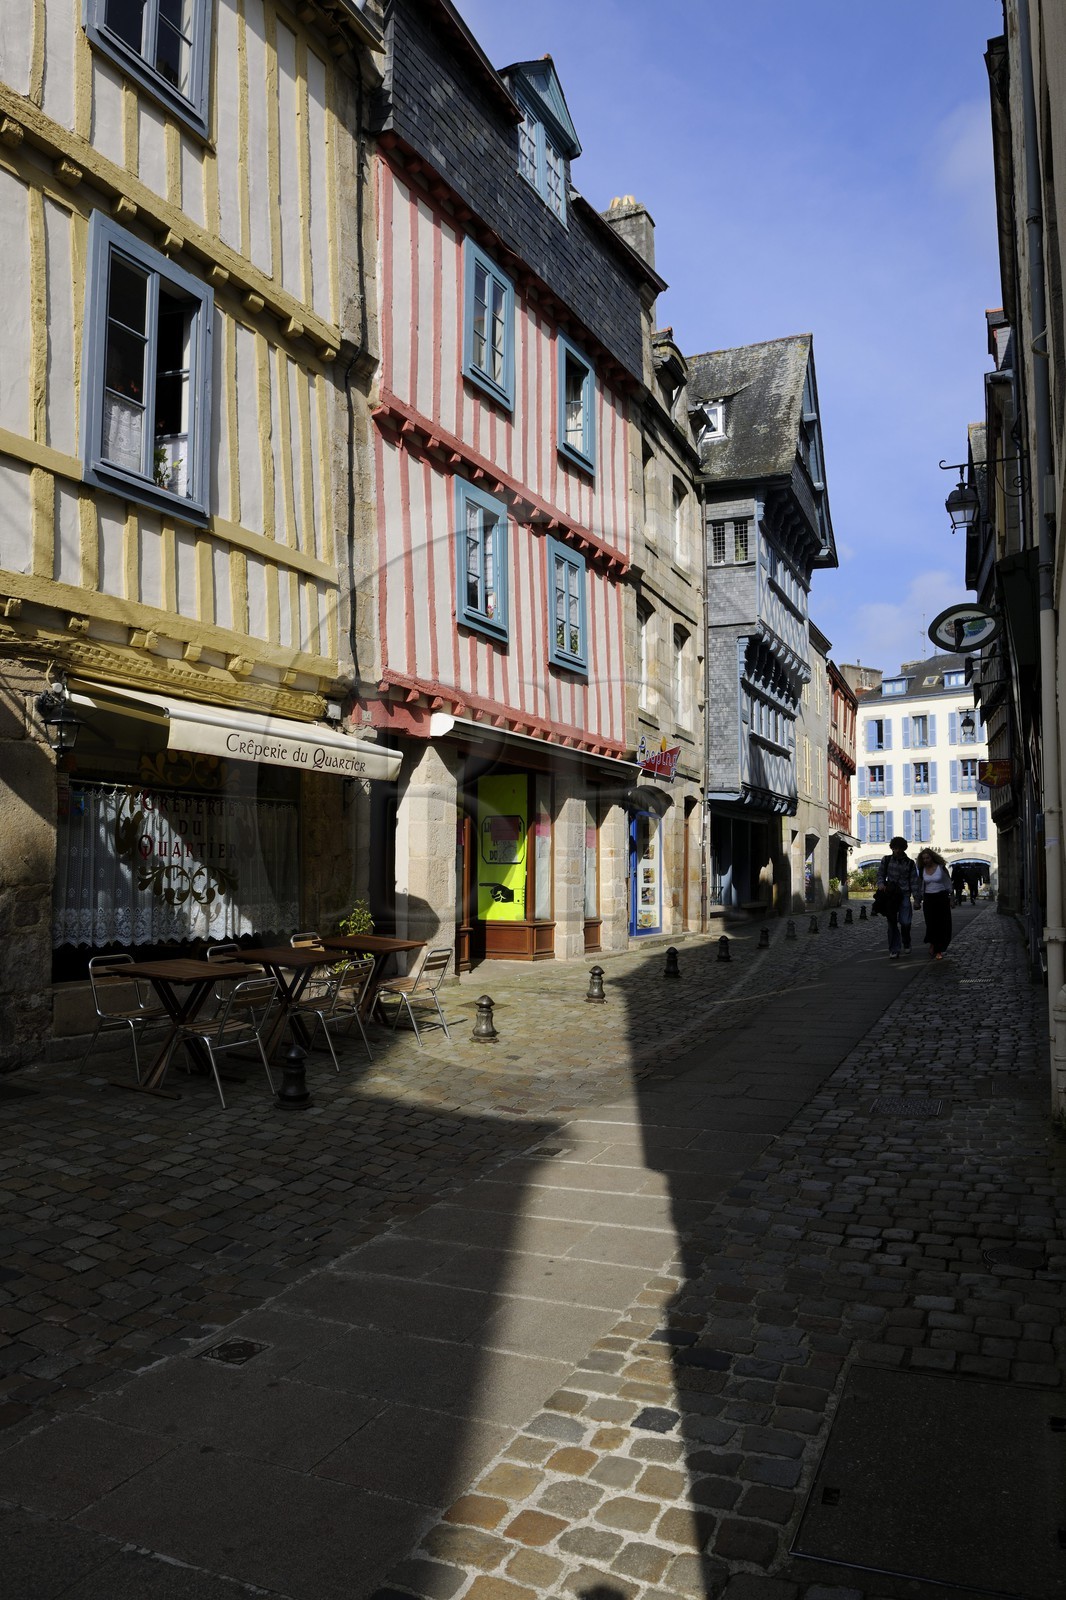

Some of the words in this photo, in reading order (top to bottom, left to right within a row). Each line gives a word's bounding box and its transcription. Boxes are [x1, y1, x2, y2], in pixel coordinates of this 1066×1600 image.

[226, 733, 288, 760] Crêperie
[292, 747, 308, 763] du
[312, 748, 366, 773] Quartier
[179, 820, 201, 835] DU
[138, 835, 237, 860] QUARTIER
